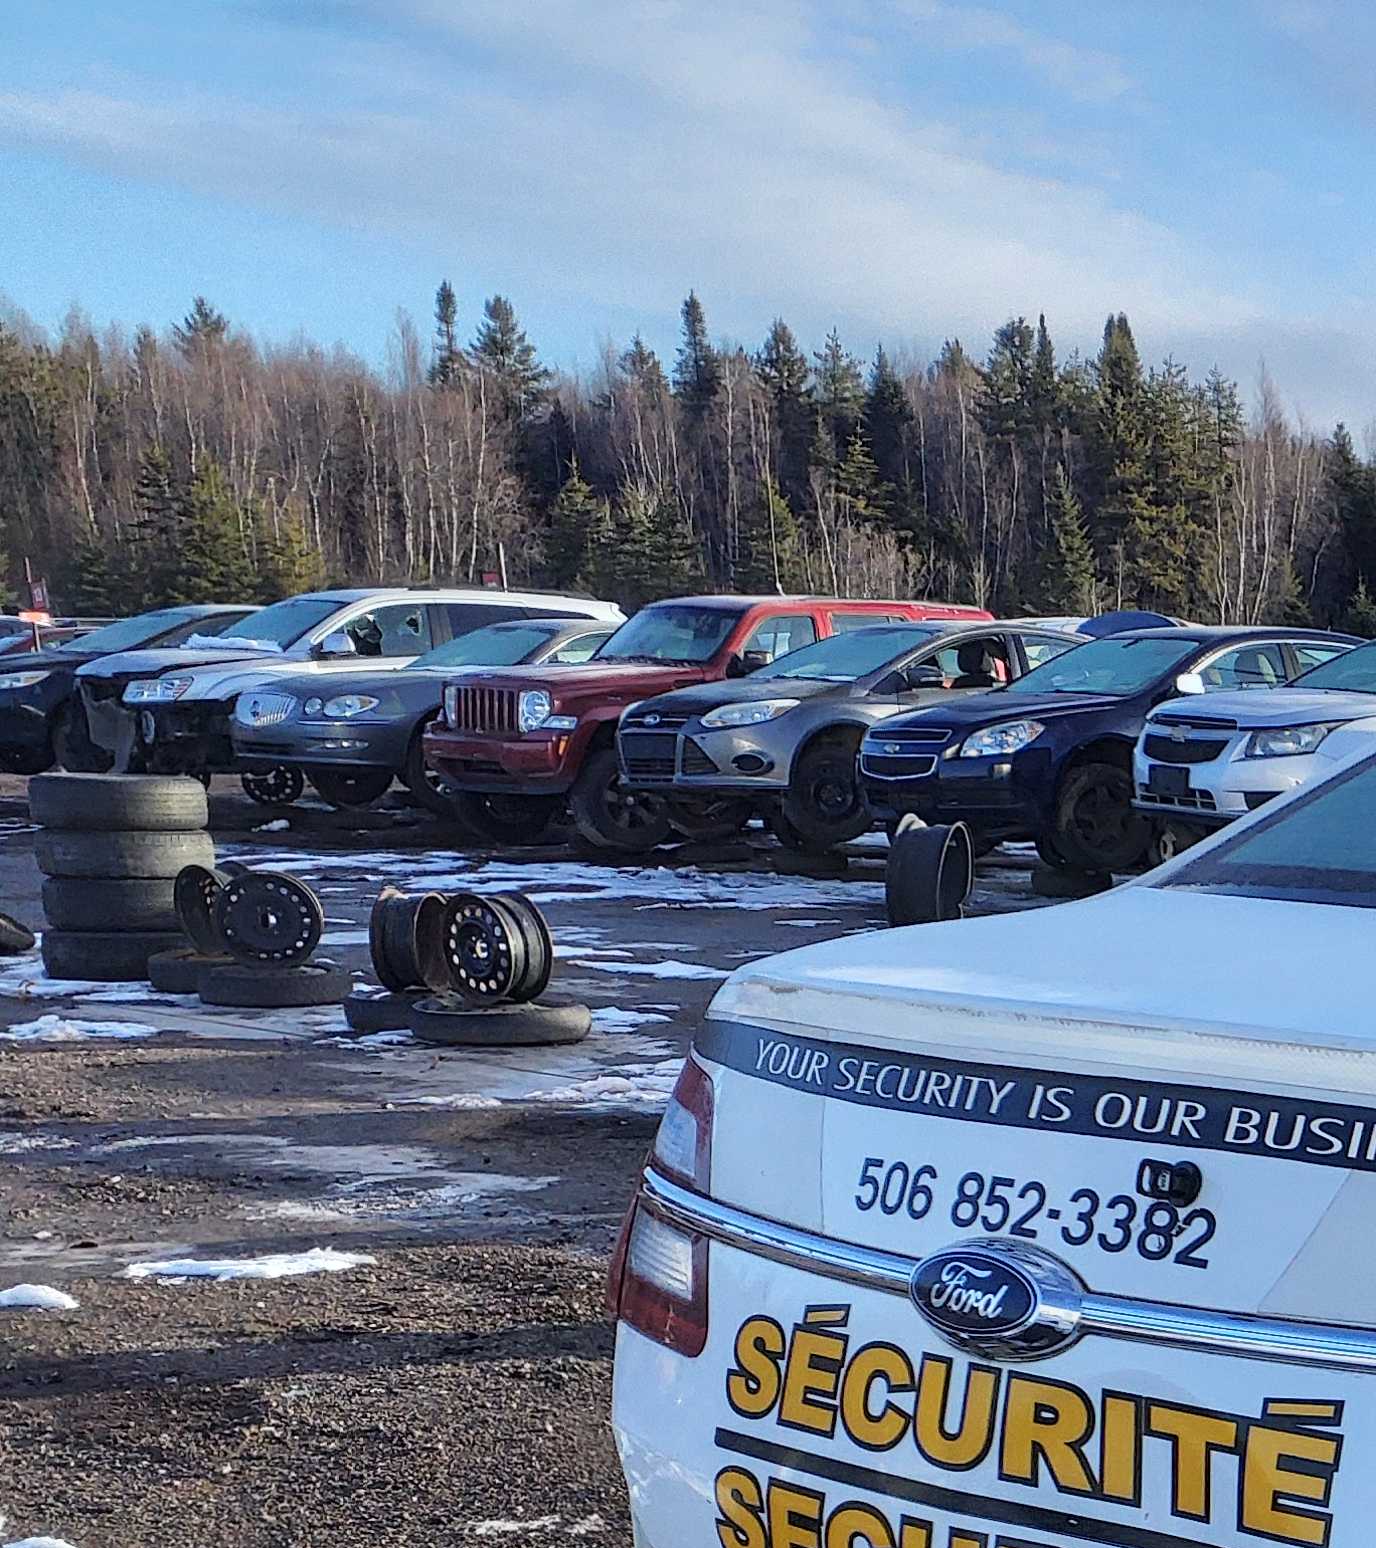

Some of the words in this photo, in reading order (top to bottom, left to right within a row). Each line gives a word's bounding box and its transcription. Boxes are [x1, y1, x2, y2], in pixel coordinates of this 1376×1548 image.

[754, 1038, 831, 1086] YOUR
[833, 1057, 1016, 1116] SECURITY
[1027, 1083, 1075, 1123] IS
[1093, 1091, 1207, 1140] OUR
[855, 1157, 939, 1221] 506
[950, 1171, 1218, 1270] 852-3382
[930, 1261, 1009, 1319] Ford
